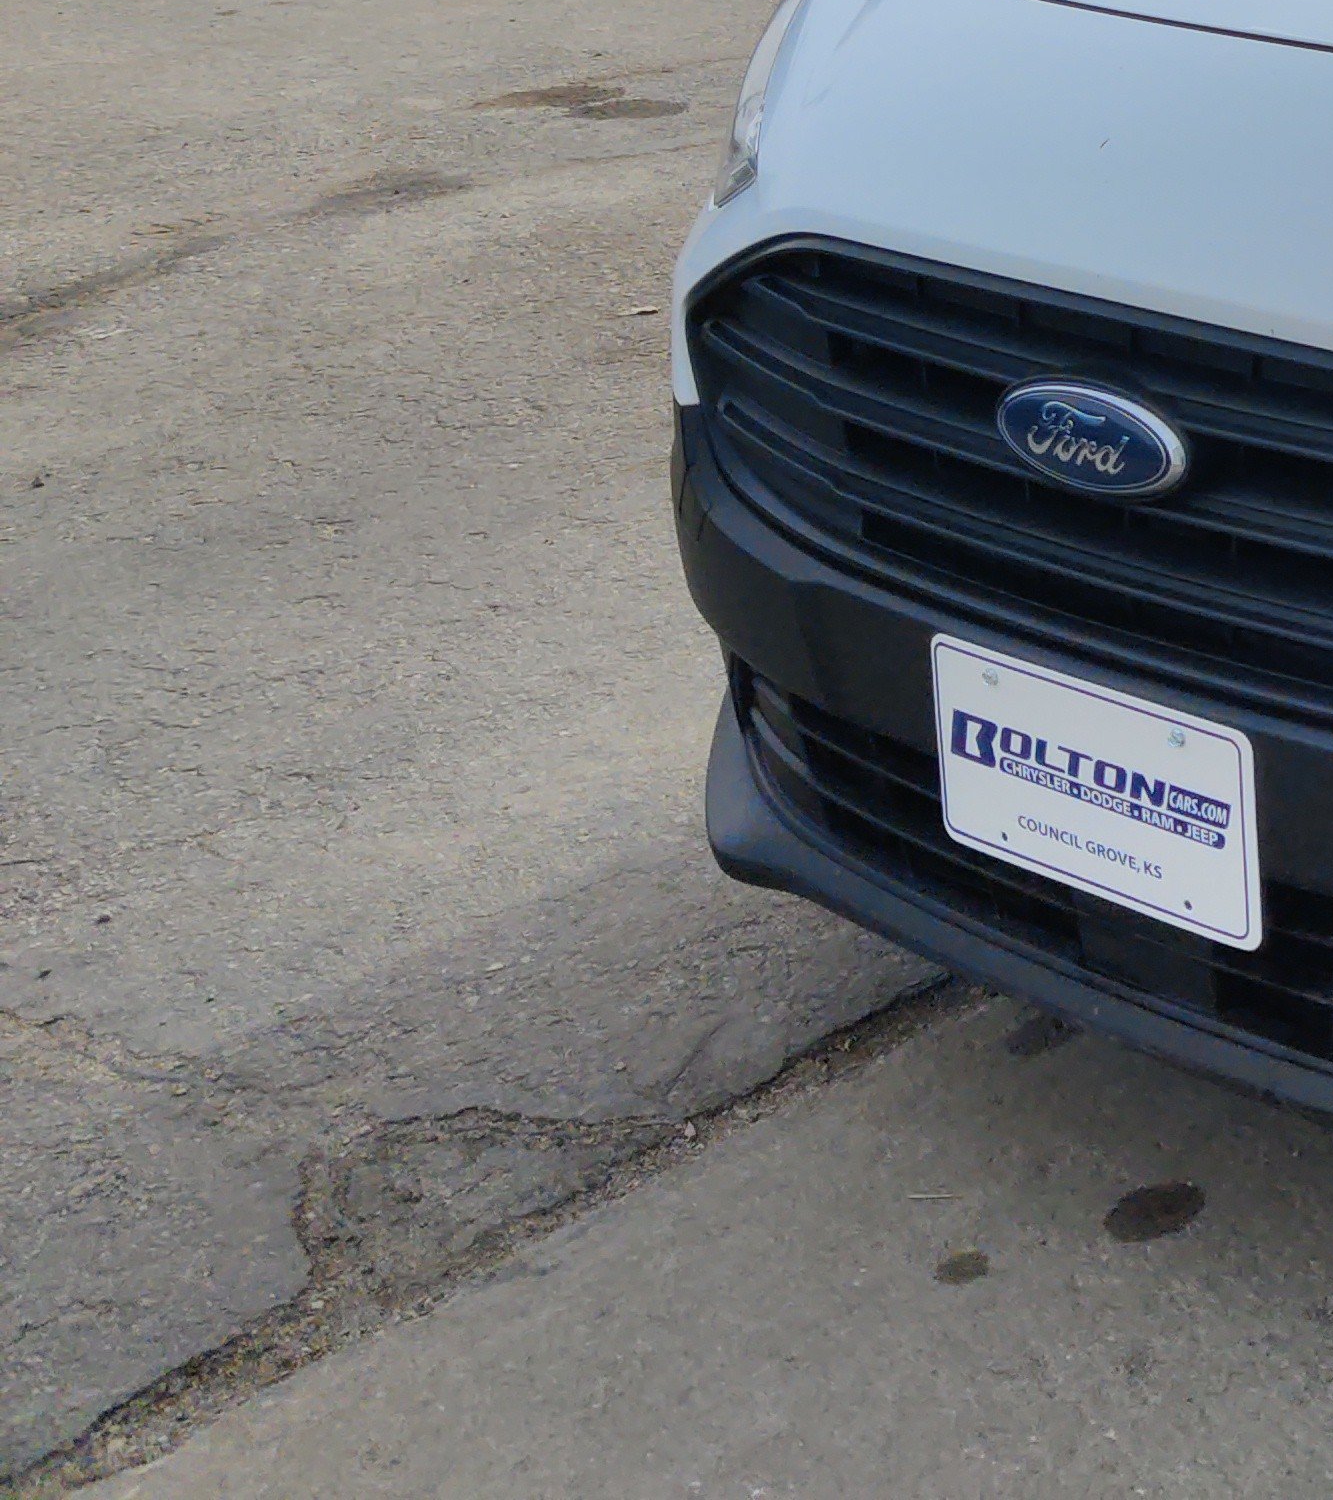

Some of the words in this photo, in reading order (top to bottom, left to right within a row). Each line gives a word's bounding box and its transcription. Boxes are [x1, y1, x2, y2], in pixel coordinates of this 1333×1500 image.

[1026, 400, 1130, 476] Ford
[951, 708, 1166, 807] BOLTON
[1168, 790, 1228, 826] CARS.COM
[1002, 759, 1072, 795] CHRYSLER
[1080, 786, 1132, 817] DODGE
[1141, 807, 1175, 832] RAM
[1183, 823, 1219, 846] JEEP
[1018, 815, 1081, 850] COUNCIL
[1085, 840, 1140, 874] GROVE,
[1143, 861, 1163, 879] KS
